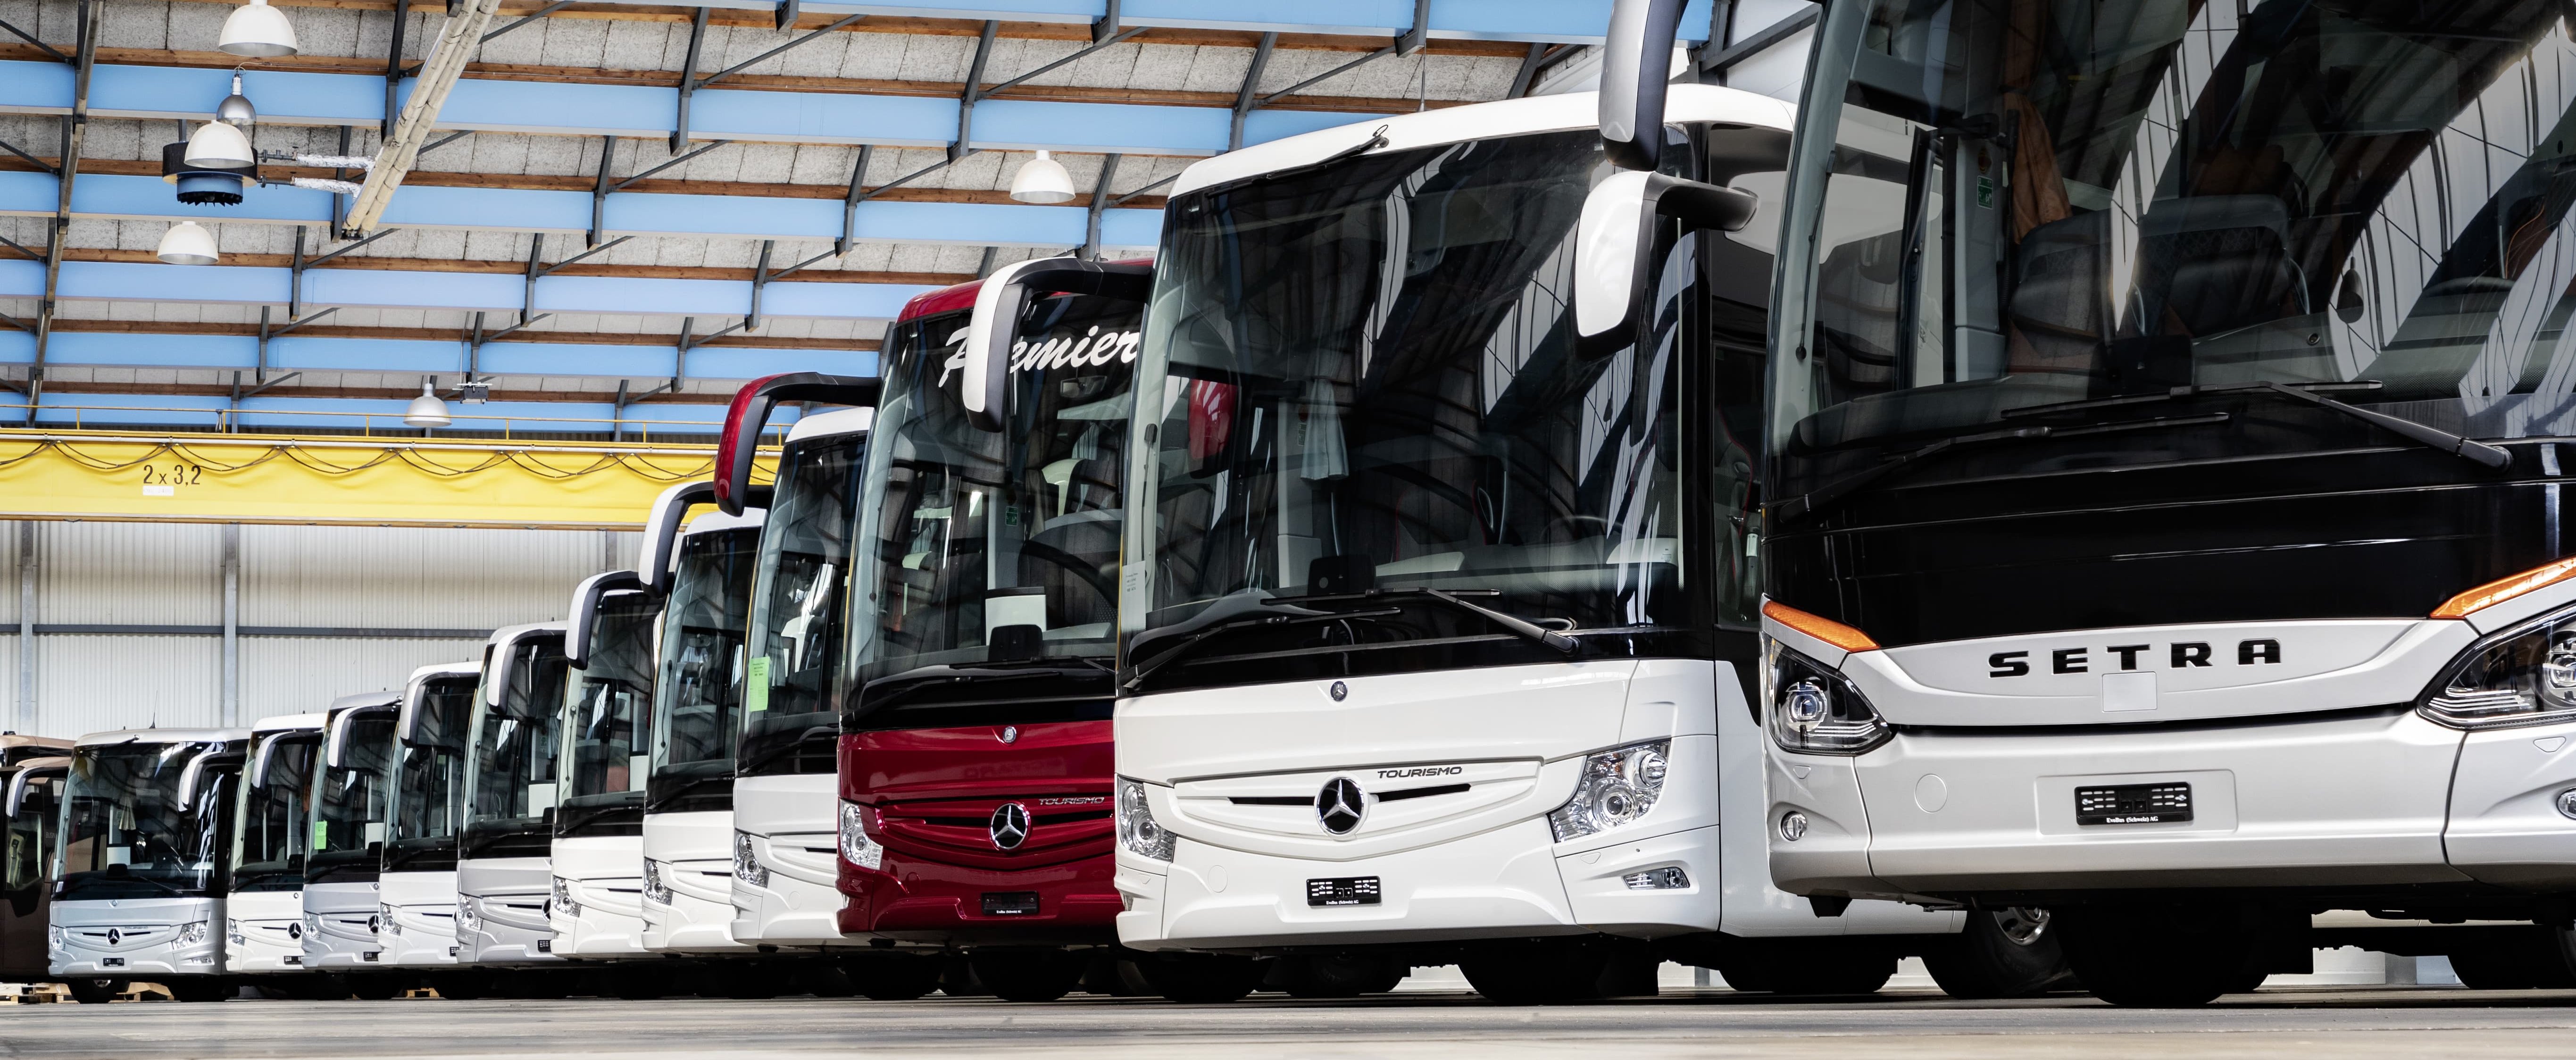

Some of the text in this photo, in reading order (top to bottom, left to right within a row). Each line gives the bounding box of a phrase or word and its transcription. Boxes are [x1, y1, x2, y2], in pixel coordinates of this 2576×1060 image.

[143, 465, 201, 487] 2 x 3,2
[1988, 638, 2281, 678] SETRA
[1377, 766, 1462, 778] TOURISMO
[1039, 797, 1105, 805] TOURISMO
